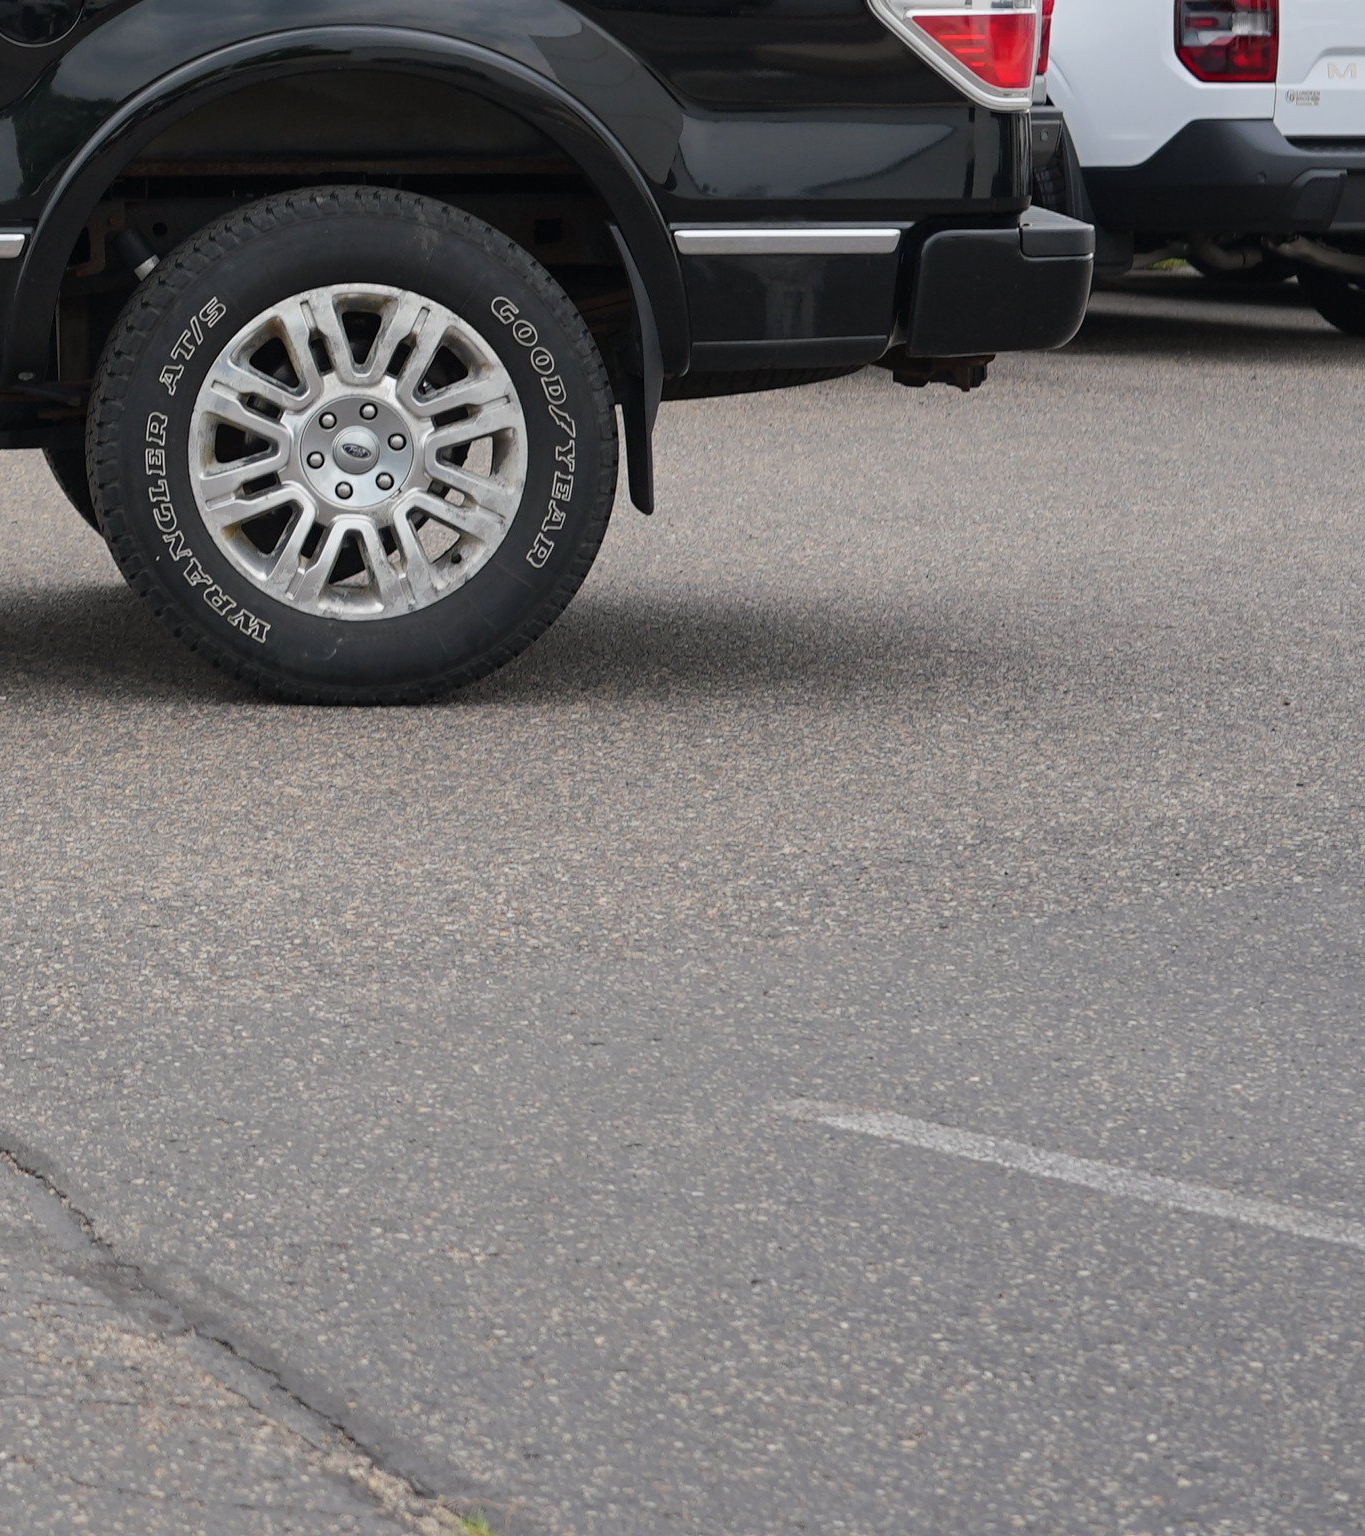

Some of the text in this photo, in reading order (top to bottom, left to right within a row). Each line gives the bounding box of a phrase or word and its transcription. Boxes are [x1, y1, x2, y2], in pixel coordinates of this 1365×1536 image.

[144, 296, 271, 644] WRANGLER AT/S
[490, 295, 577, 569] GOODYEAR
